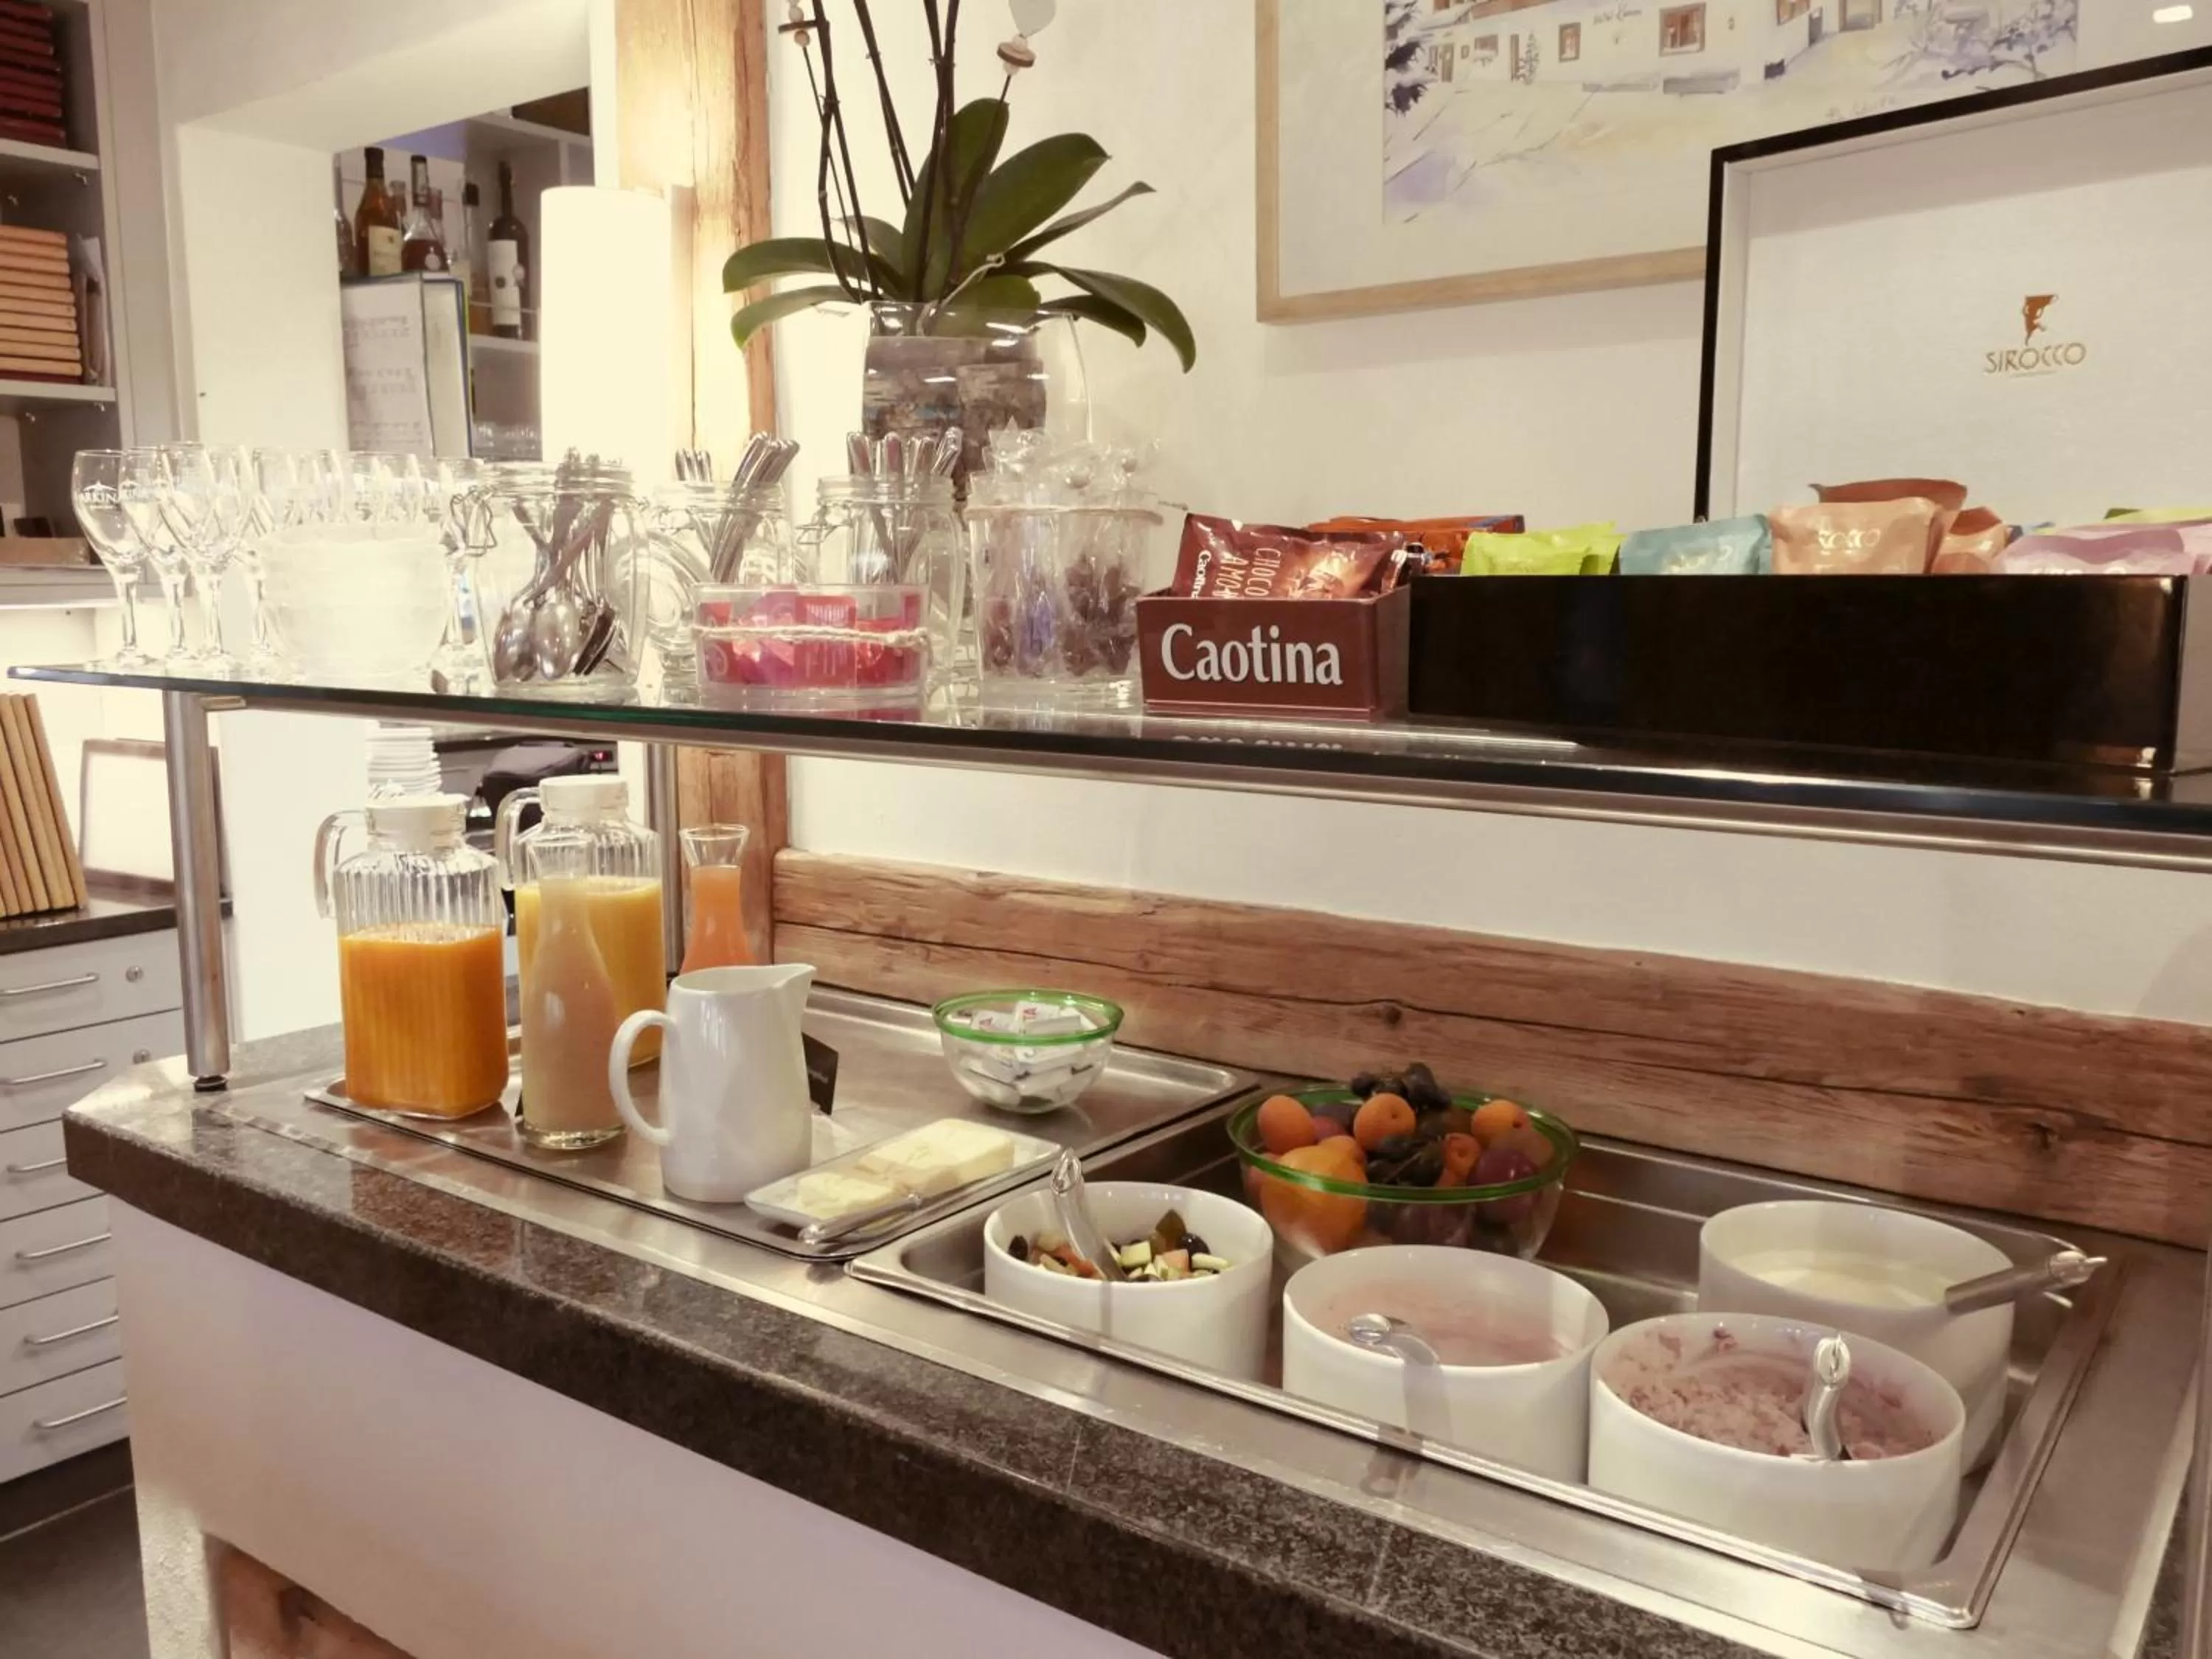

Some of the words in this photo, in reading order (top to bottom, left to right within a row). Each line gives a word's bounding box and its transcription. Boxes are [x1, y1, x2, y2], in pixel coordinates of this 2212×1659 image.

[1983, 342, 2086, 373] SIROCCO
[1244, 547, 1281, 597] CHOCO
[1161, 622, 1343, 685] Caotina
